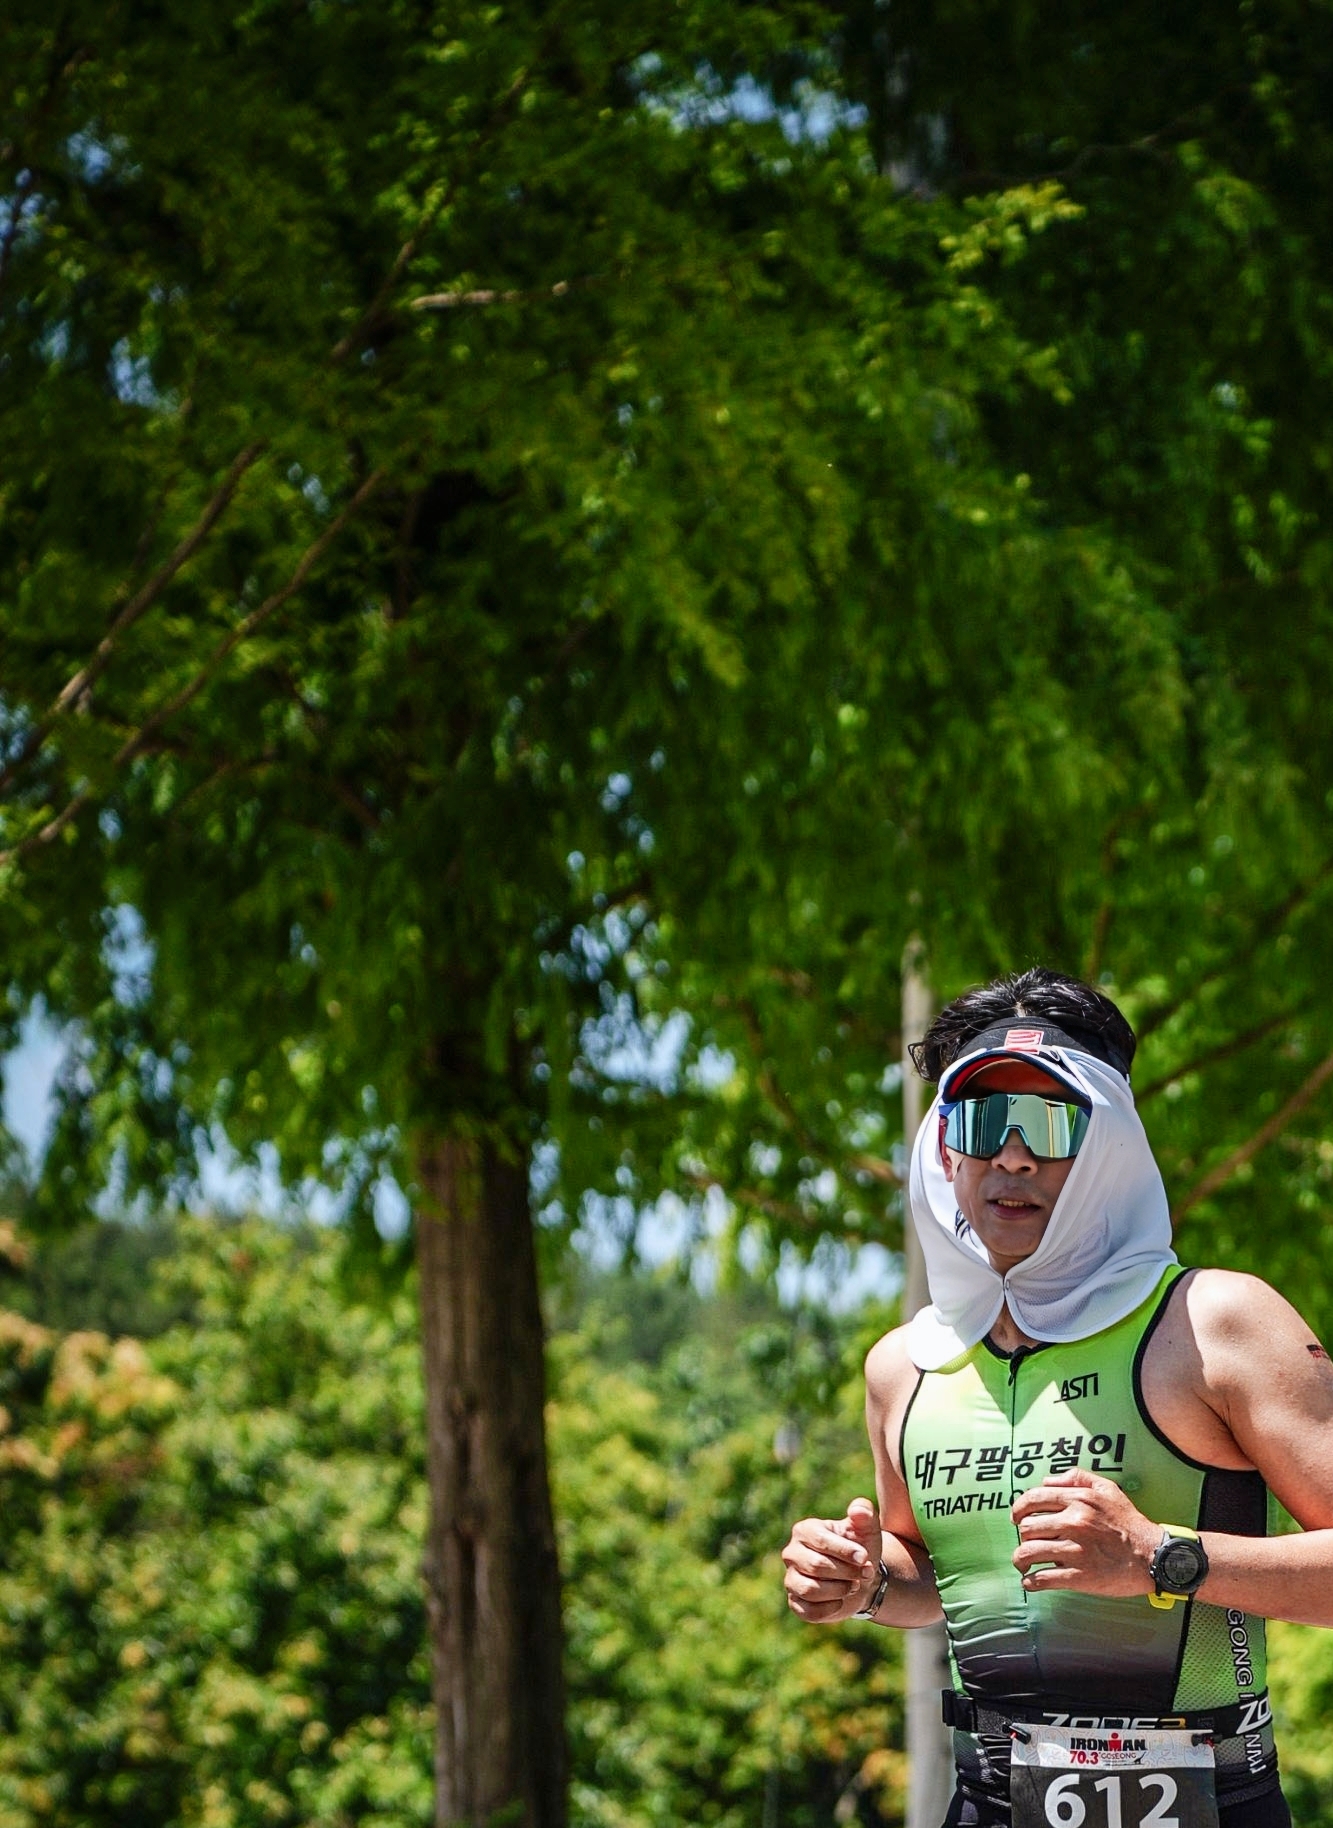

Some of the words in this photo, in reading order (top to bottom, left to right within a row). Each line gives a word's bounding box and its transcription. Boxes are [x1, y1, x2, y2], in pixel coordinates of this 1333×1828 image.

[914, 1433, 1127, 1490] 대구팔공철인
[1070, 1732, 1147, 1752] IRONMAN
[1069, 1750, 1099, 1765] 70.3
